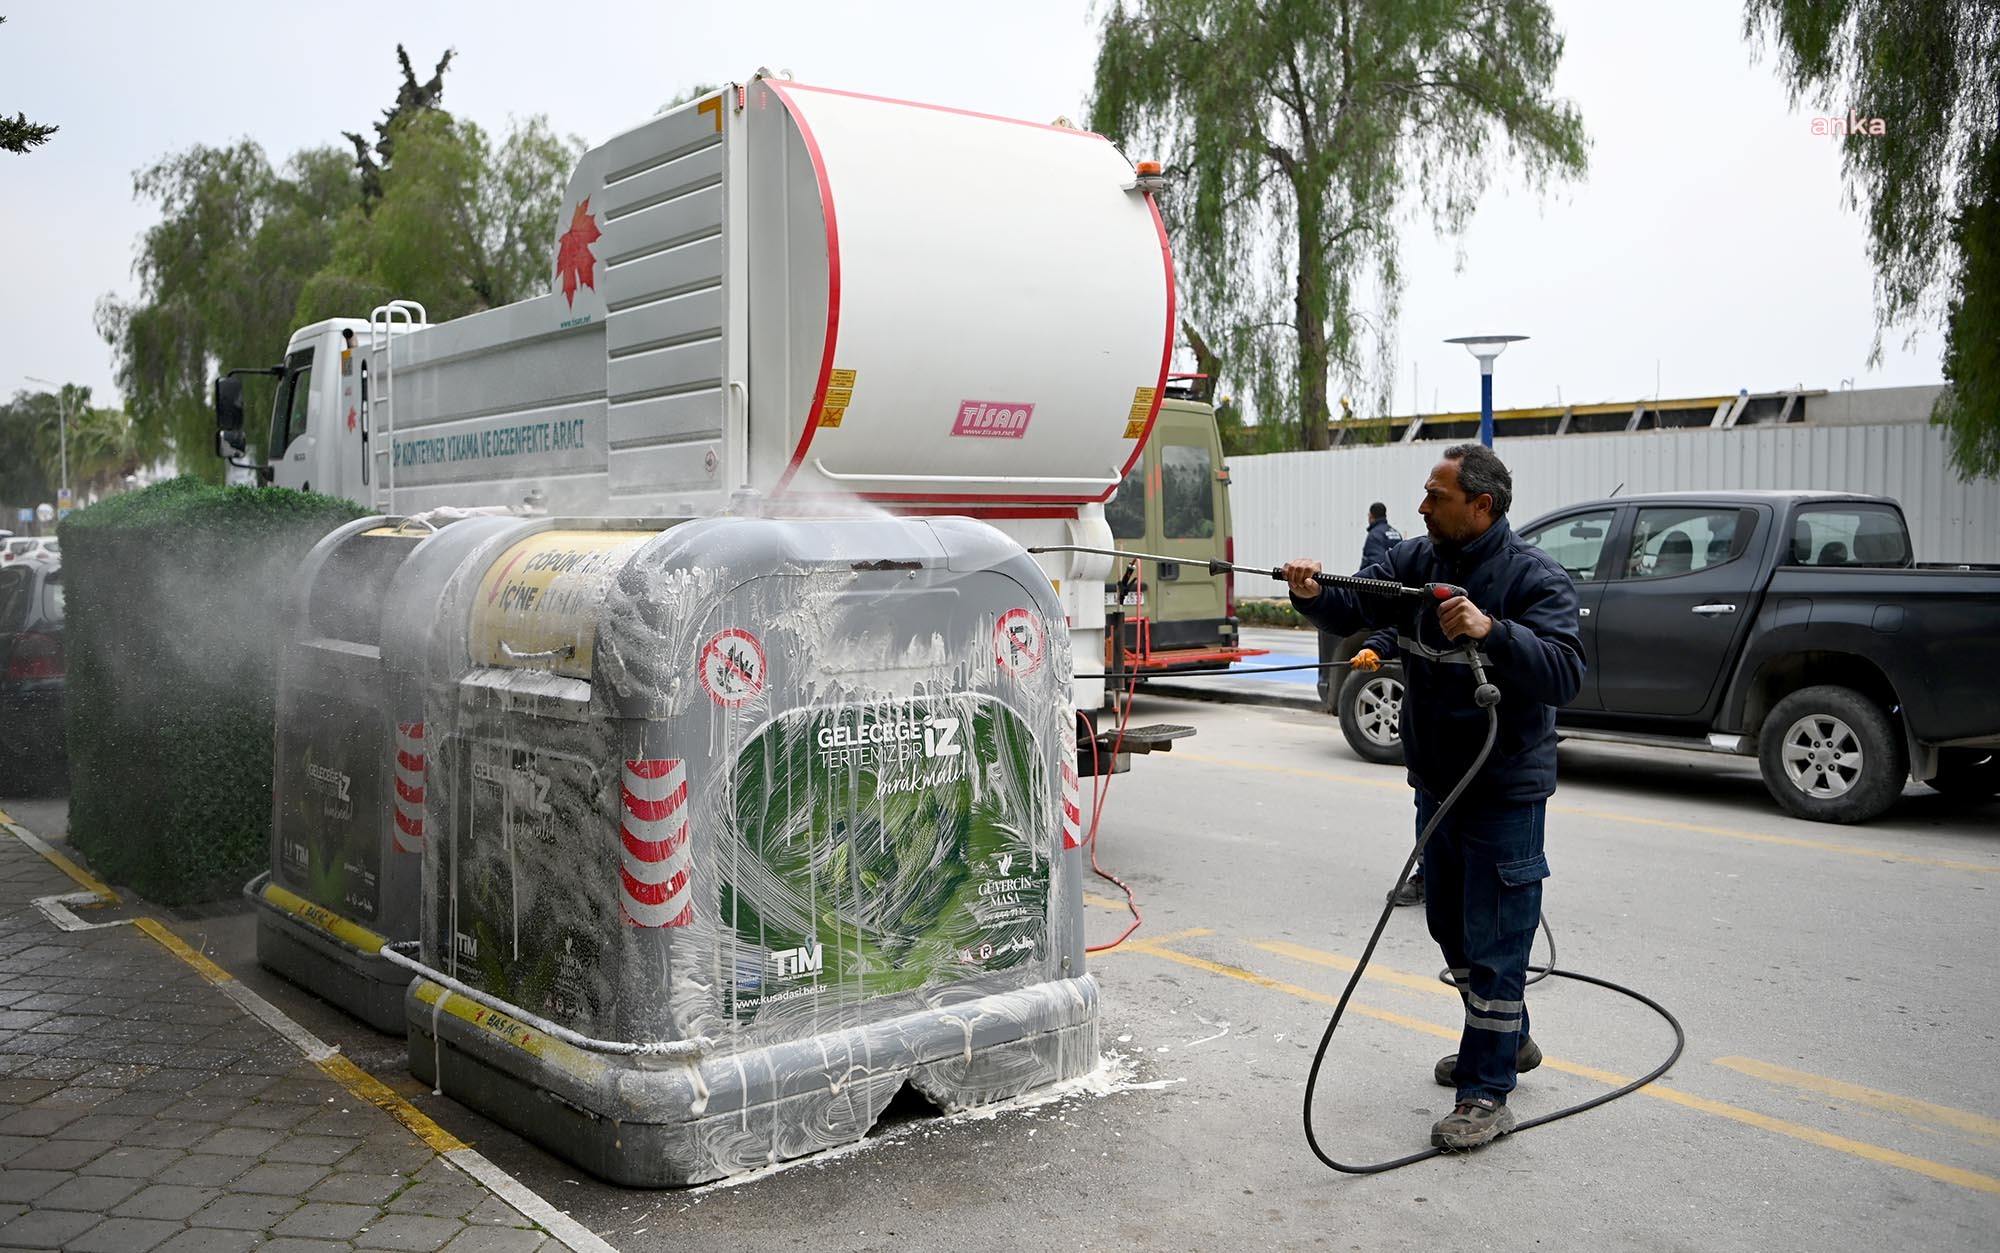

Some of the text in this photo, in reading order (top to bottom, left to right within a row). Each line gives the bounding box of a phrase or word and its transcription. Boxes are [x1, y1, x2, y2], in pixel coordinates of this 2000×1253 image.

[402, 437, 446, 466] KONTEYNER
[447, 432, 480, 462] YIKAMA
[480, 429, 493, 458] VE
[493, 422, 550, 456] DEZENFEKTE
[552, 418, 585, 449] ARACI
[990, 891, 1021, 908] MASA
[487, 1013, 507, 1031] BAS
